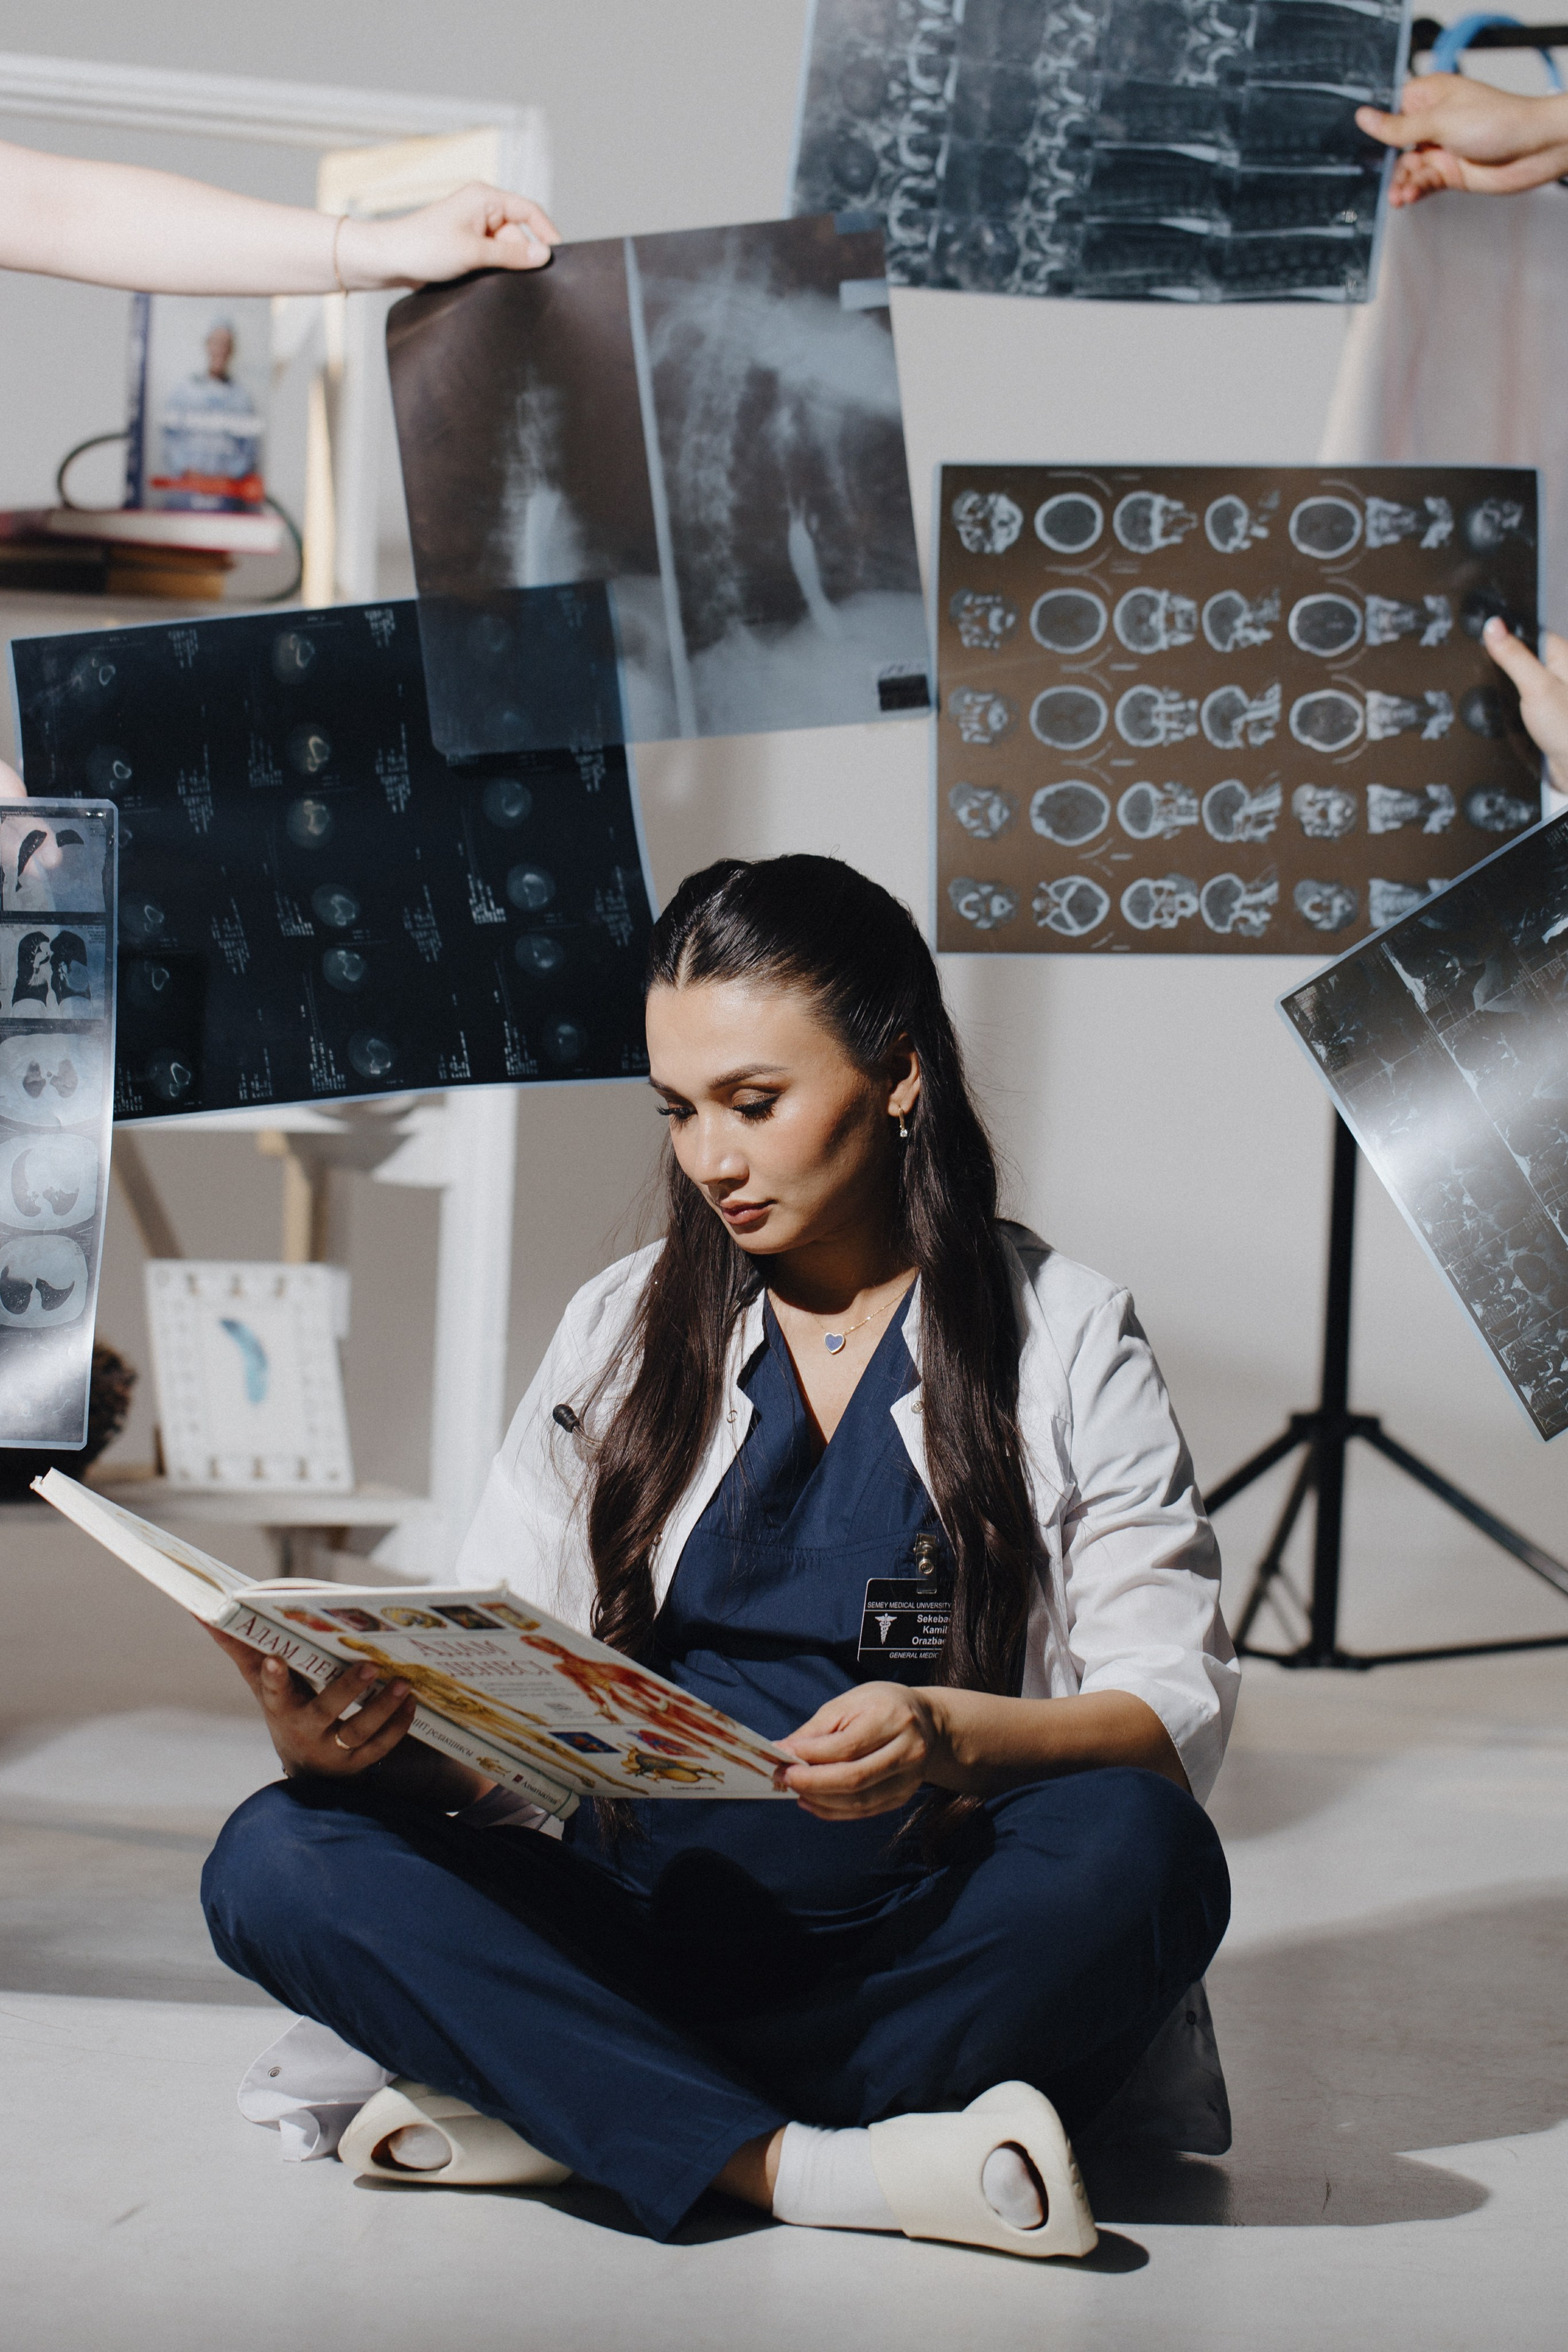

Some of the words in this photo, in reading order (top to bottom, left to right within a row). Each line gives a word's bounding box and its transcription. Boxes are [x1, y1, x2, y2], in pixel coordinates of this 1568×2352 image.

[917, 1614, 951, 1623] Sekeba
[235, 1615, 300, 1659] АДАМ
[408, 1637, 507, 1657] АДАМ
